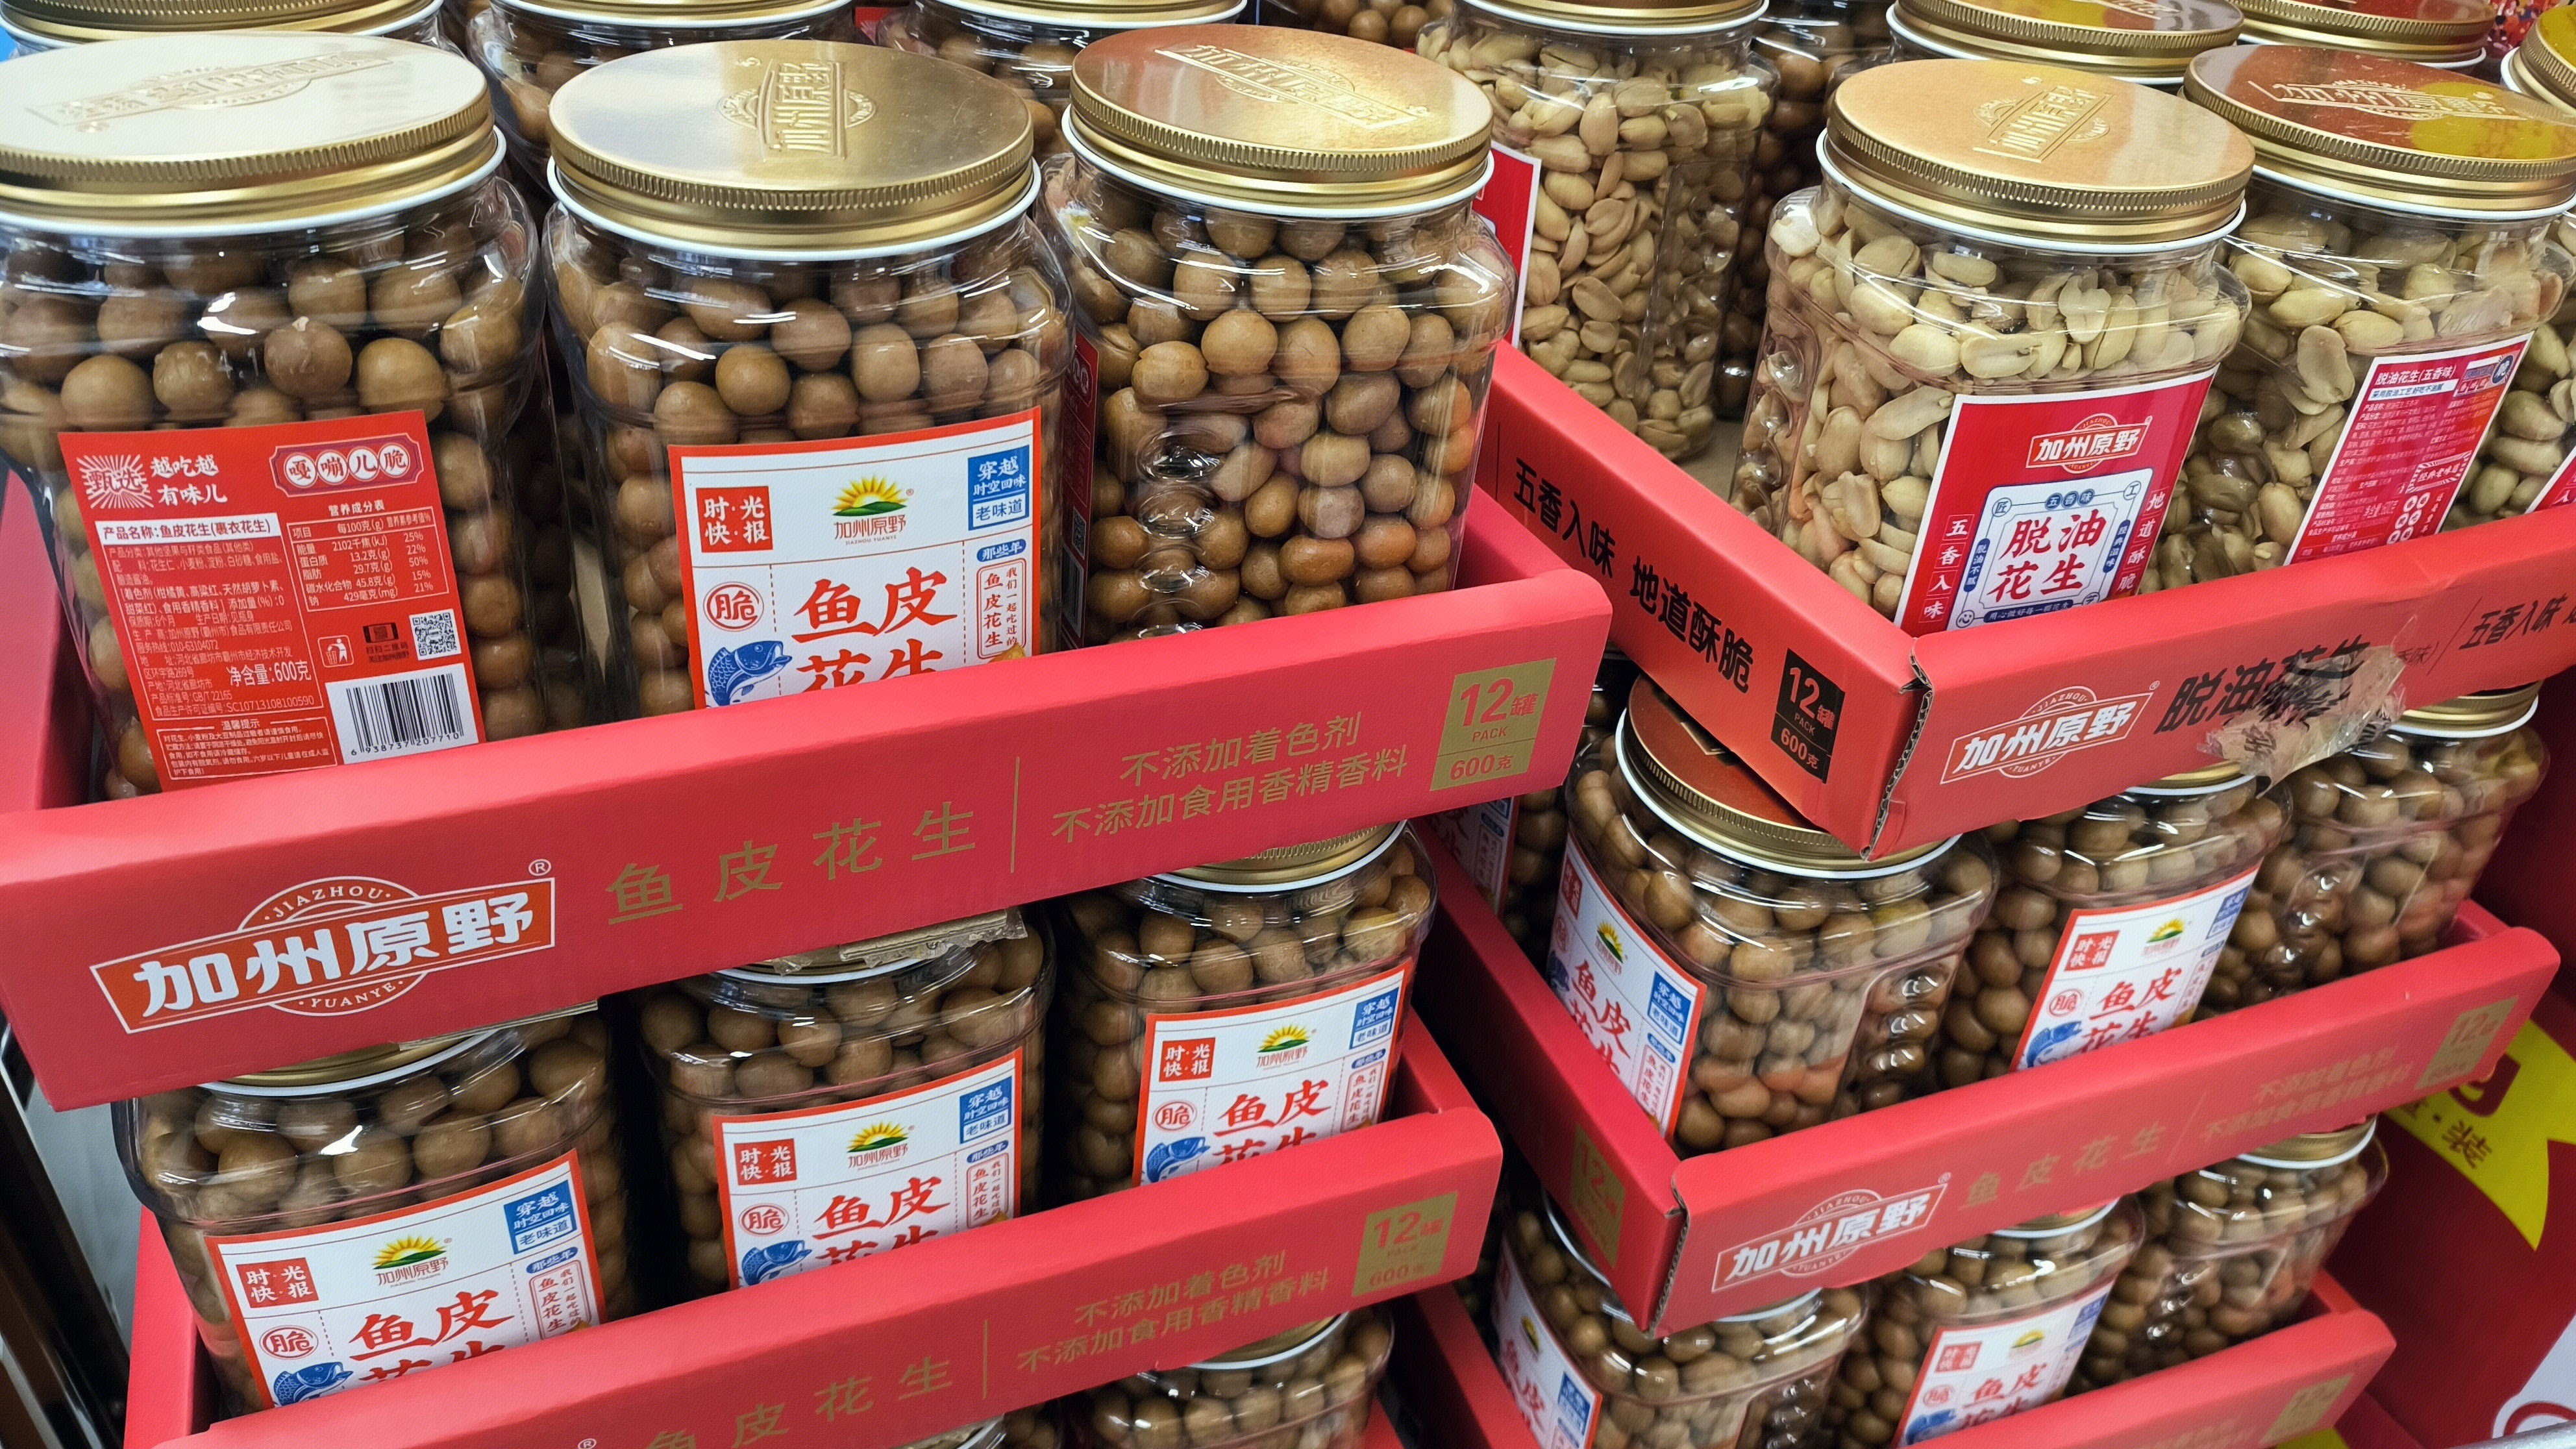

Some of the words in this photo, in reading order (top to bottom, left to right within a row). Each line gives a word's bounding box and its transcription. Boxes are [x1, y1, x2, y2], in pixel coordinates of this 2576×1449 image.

[2375, 364, 2457, 386] 脱油花生(五香味)
[2033, 428, 2141, 462] 加州原野
[150, 454, 219, 479] 越吃越
[288, 449, 407, 481] 嘎嘣儿脆
[977, 456, 1019, 482] 穿越
[158, 483, 228, 506] 有味儿
[972, 473, 1027, 497] 时空回味
[2125, 483, 2140, 497] 工
[328, 499, 385, 517] 营养成分表
[974, 498, 1024, 521] 老味道
[1995, 501, 2009, 514] 匠
[2047, 492, 2092, 508] 五香味
[103, 519, 271, 540] 产品名称:鱼皮花生(裹衣花生)
[292, 526, 312, 539] 项目
[834, 514, 907, 542] 加州原野
[1998, 508, 2107, 560] 脱油
[2117, 491, 2165, 592] 地道酥脆
[296, 544, 316, 556] 能量
[403, 531, 424, 543] 25%
[299, 555, 328, 569] 蛋白质
[405, 543, 426, 555] 22%
[980, 540, 1024, 562] 那些年
[303, 569, 323, 581] 脂肪
[408, 555, 428, 567] 50%
[305, 578, 353, 594] 碳水化合物
[411, 569, 432, 582] 15%
[1513, 457, 1616, 578] 五香入味
[1629, 556, 1753, 695] 地道酥脆
[1923, 518, 1968, 619] 五香入味
[1987, 553, 2086, 603] 花生
[308, 595, 320, 608] 钠
[413, 581, 434, 593] 21%
[715, 591, 758, 624] 脆
[791, 566, 958, 644] 鱼皮
[1005, 566, 1018, 647] 我们一起吃过的
[982, 572, 1004, 649] 鱼皮花生
[2458, 592, 2568, 650] 五香入味
[226, 660, 312, 688] 净含量:600克
[1461, 677, 1539, 727] 12罐
[1788, 666, 1835, 732] 12罐
[2037, 691, 2087, 712] JIAZHOU
[1472, 726, 1508, 742] PACK
[1793, 712, 1816, 736] PACK
[1952, 700, 2136, 774] 加州原野
[365, 739, 409, 754] 938737
[415, 732, 460, 747] 207710
[1119, 711, 1363, 787] 不添加着色剂
[1780, 727, 1819, 770] 600克
[1450, 754, 1514, 780] 600克
[1050, 744, 1408, 844] 不添加食用香精香料
[604, 801, 976, 926] 鱼皮花生
[273, 884, 383, 919] JIAZHOU
[133, 892, 534, 1018] 加州原野
[311, 981, 398, 1009] YUANYE
[2088, 967, 2183, 1021] 鱼皮
[1570, 958, 1632, 1060] 鱼皮
[967, 1085, 1003, 1109] 穿越
[1213, 1078, 1332, 1137] 鱼皮
[965, 1113, 1006, 1135] 老味道
[1159, 1106, 1193, 1127] 脆
[848, 1143, 908, 1169] 加州原野
[516, 1191, 560, 1218] 穿越
[812, 1176, 950, 1241] 鱼皮
[519, 1219, 569, 1246] 老味道
[748, 1208, 784, 1231] 脆
[1724, 1193, 1931, 1282] 加州原野
[375, 1257, 449, 1285] 加州原野
[531, 1250, 575, 1272] 那些年
[1073, 1249, 1286, 1328] 不添加着色剂
[538, 1277, 567, 1333] 鱼皮花生
[349, 1288, 515, 1361] 鱼皮
[1015, 1266, 1330, 1373] 不添加食用香精香料
[271, 1330, 312, 1355] 脆
